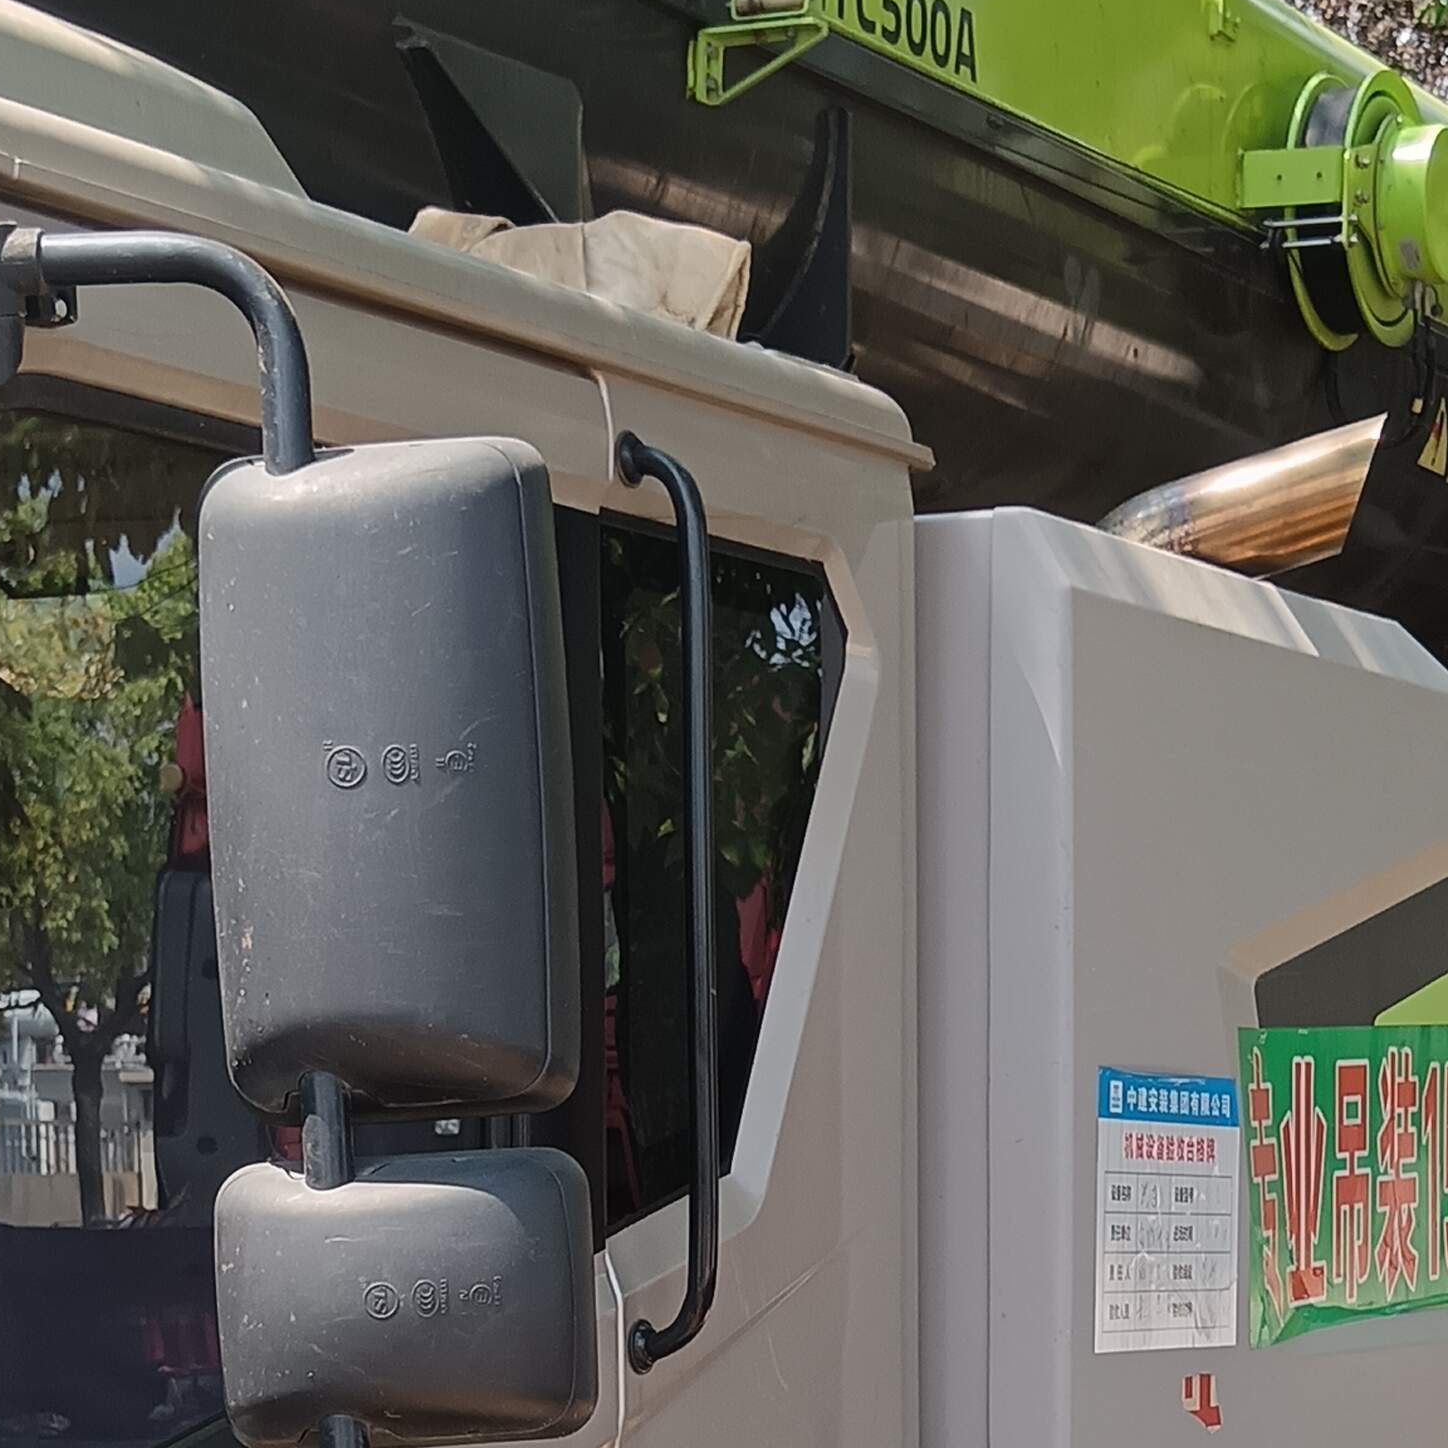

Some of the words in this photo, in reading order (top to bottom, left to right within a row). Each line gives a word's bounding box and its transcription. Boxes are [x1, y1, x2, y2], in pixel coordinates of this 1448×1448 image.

[1125, 1086, 1231, 1119] 中建安装集团有限公司
